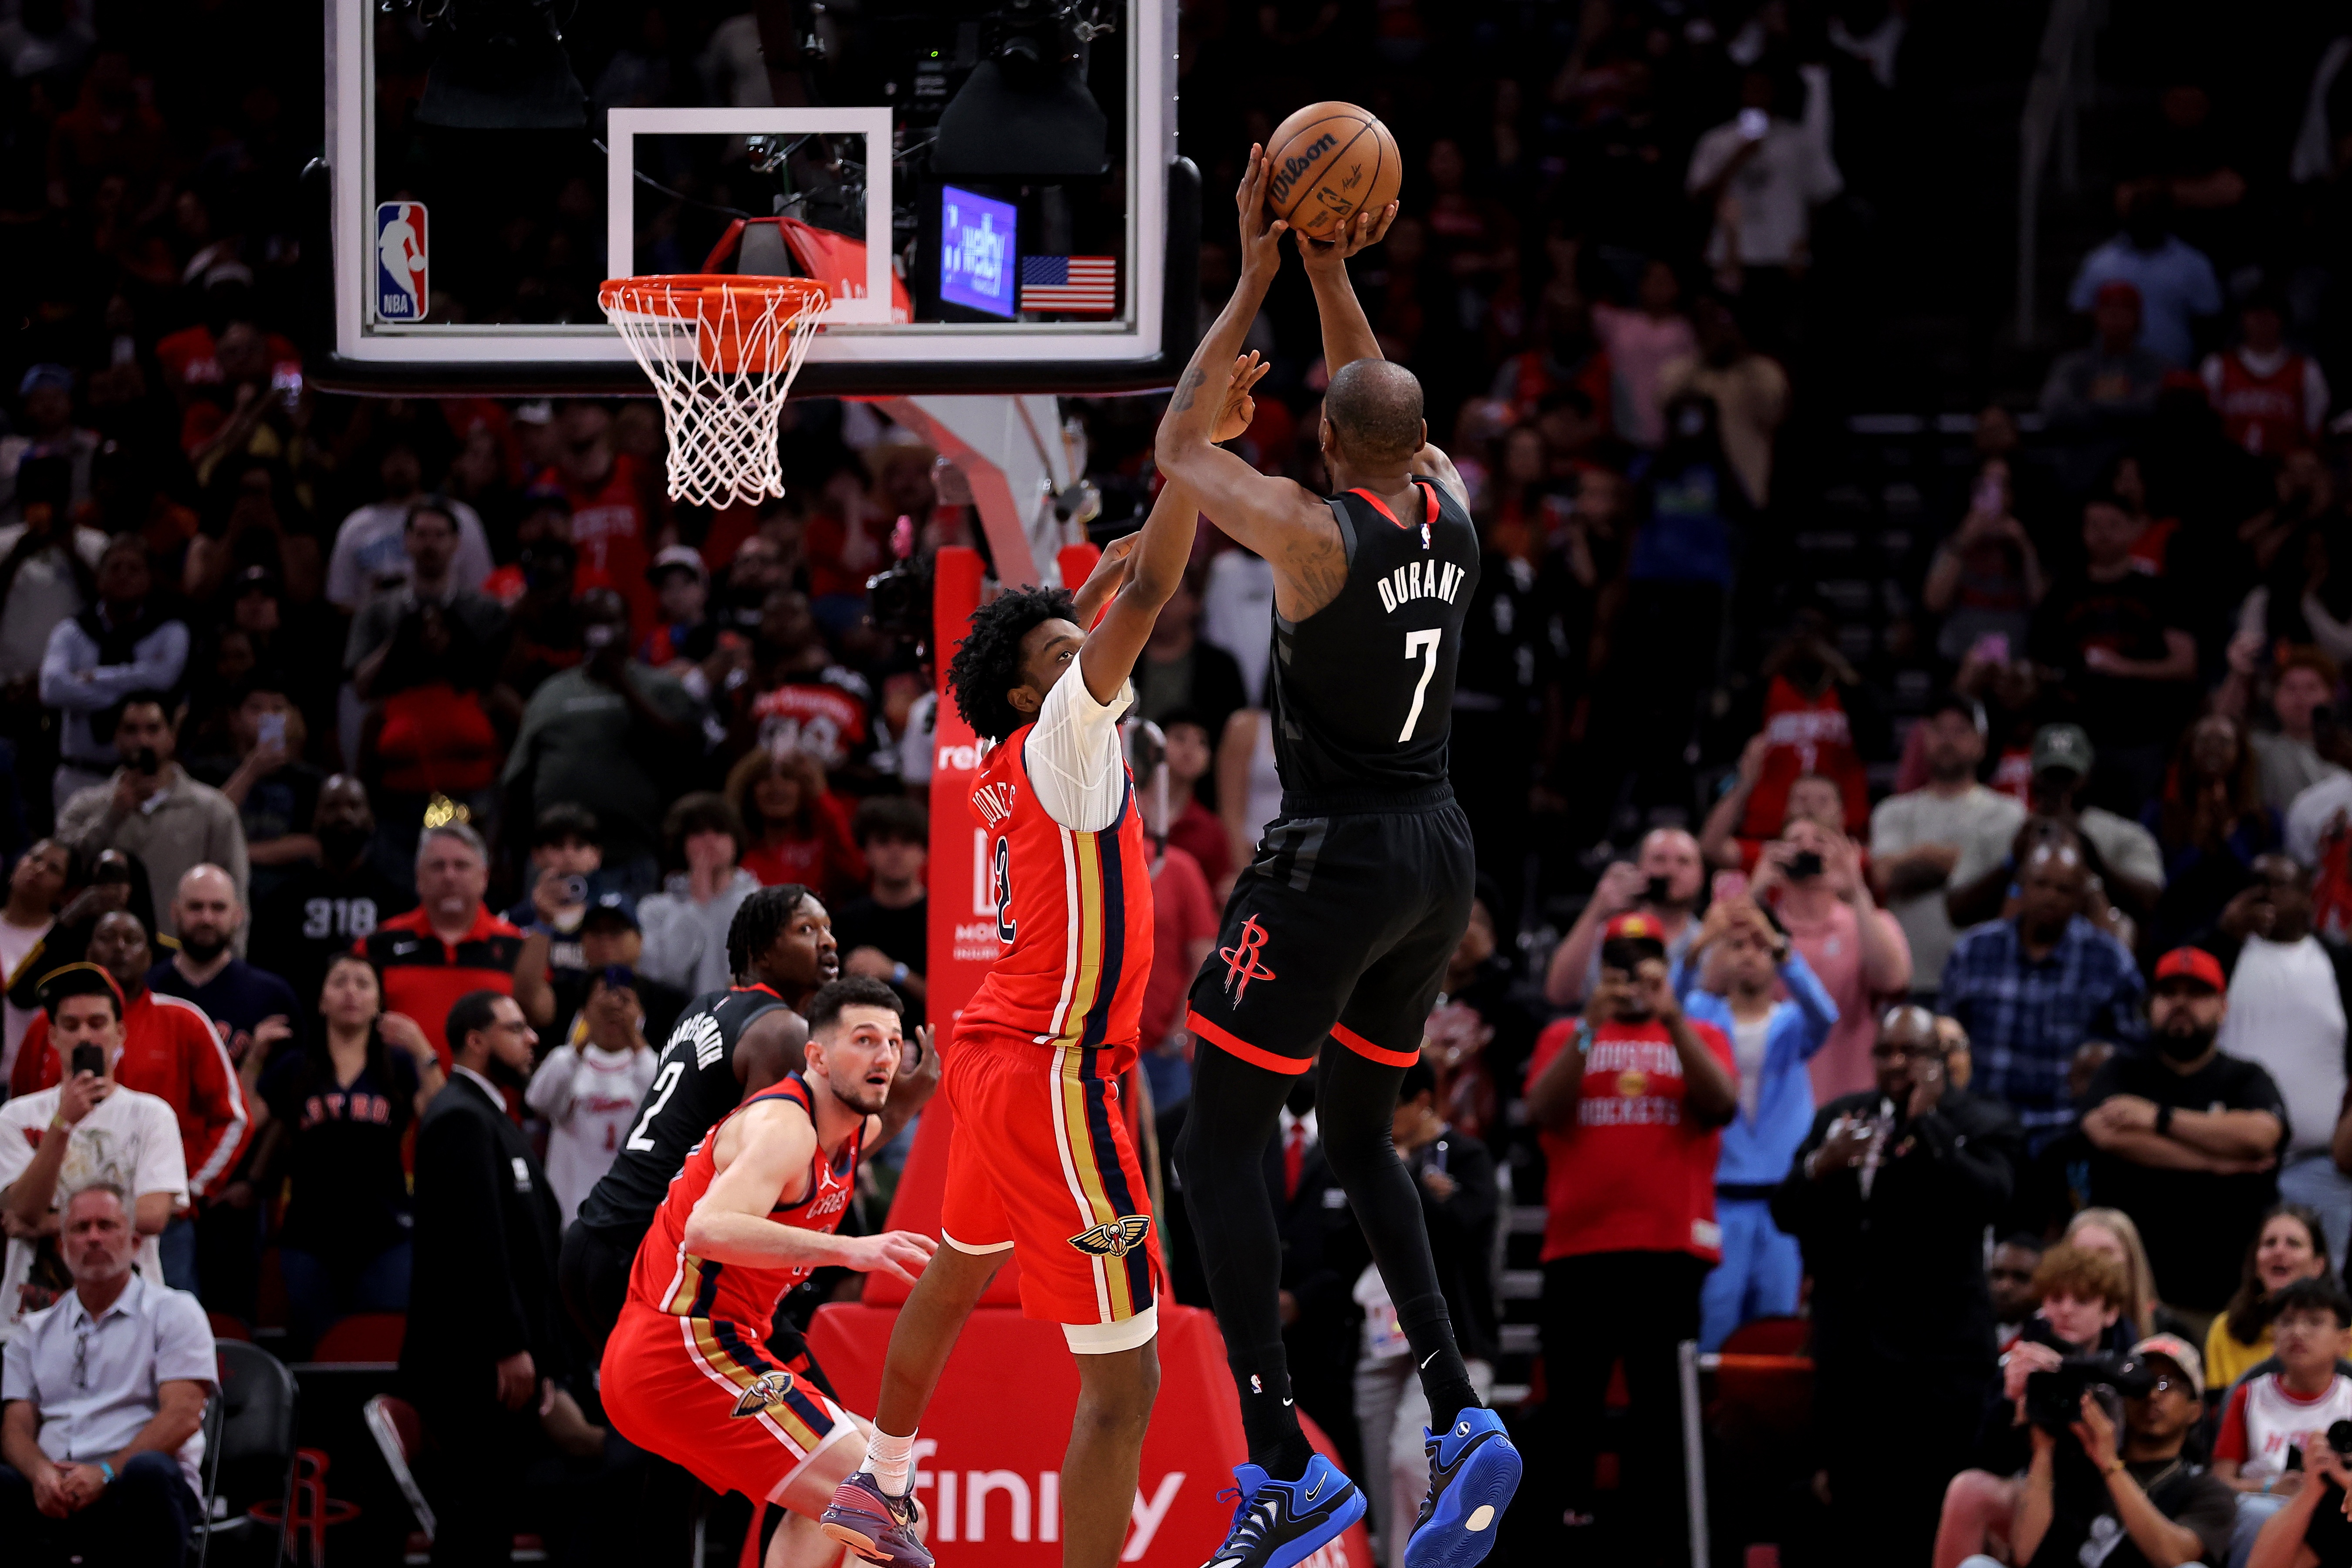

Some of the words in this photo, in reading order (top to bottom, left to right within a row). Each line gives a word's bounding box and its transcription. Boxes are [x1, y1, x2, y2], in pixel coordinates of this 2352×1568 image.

[1272, 133, 1340, 204] Wilson
[384, 294, 408, 314] NBA
[1377, 559, 1465, 614] DURANT
[1398, 628, 1441, 743] 7
[938, 737, 984, 771] rel
[972, 782, 1016, 829] JONES
[995, 835, 1016, 945] 2
[303, 897, 378, 939] 318
[300, 1093, 391, 1131] STRO
[626, 1061, 686, 1152] 2
[912, 1438, 1186, 1562] finiy
